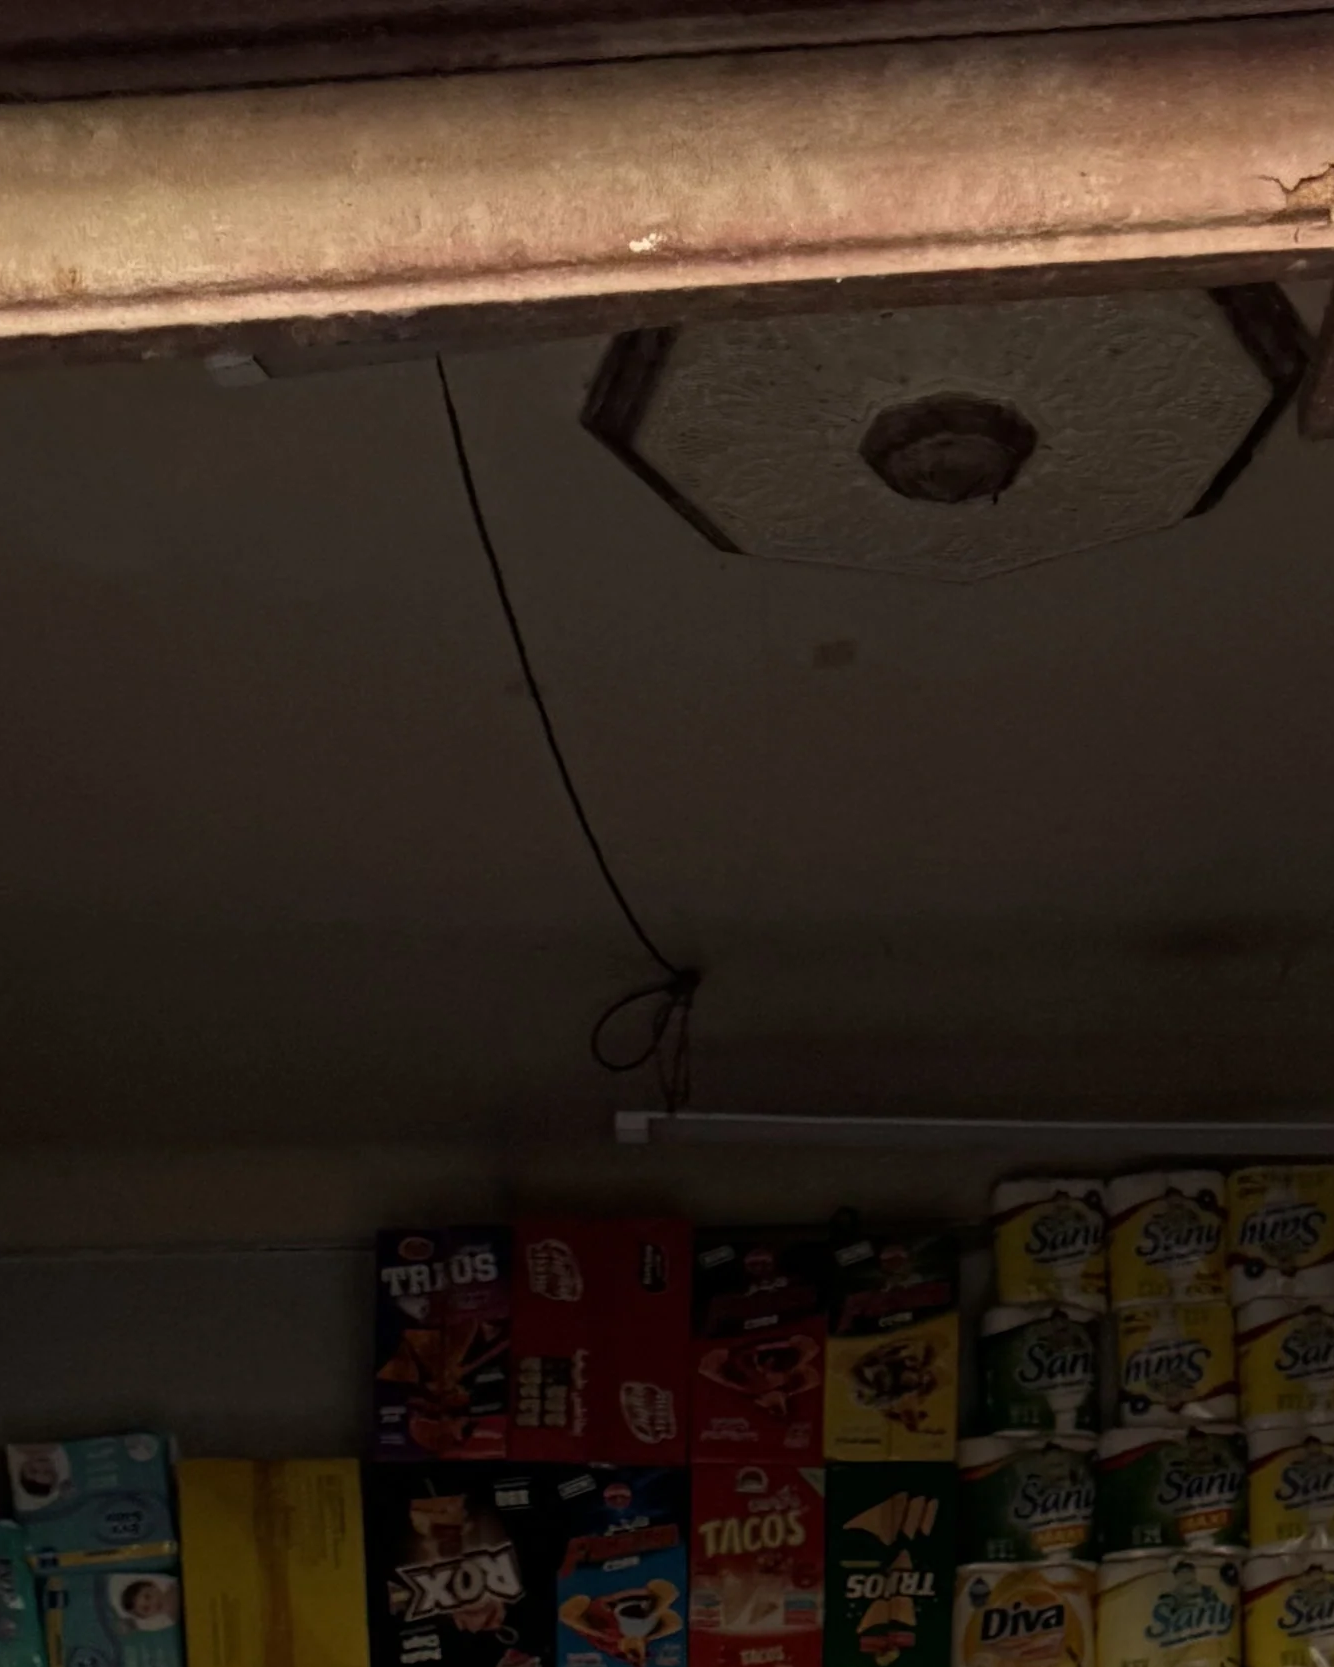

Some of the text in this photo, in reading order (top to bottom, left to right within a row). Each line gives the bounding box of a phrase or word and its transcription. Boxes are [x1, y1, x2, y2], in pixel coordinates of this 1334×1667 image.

[697, 1512, 808, 1557] TACOS
[413, 1546, 524, 1614] ROX
[979, 1600, 1065, 1642] Diva
